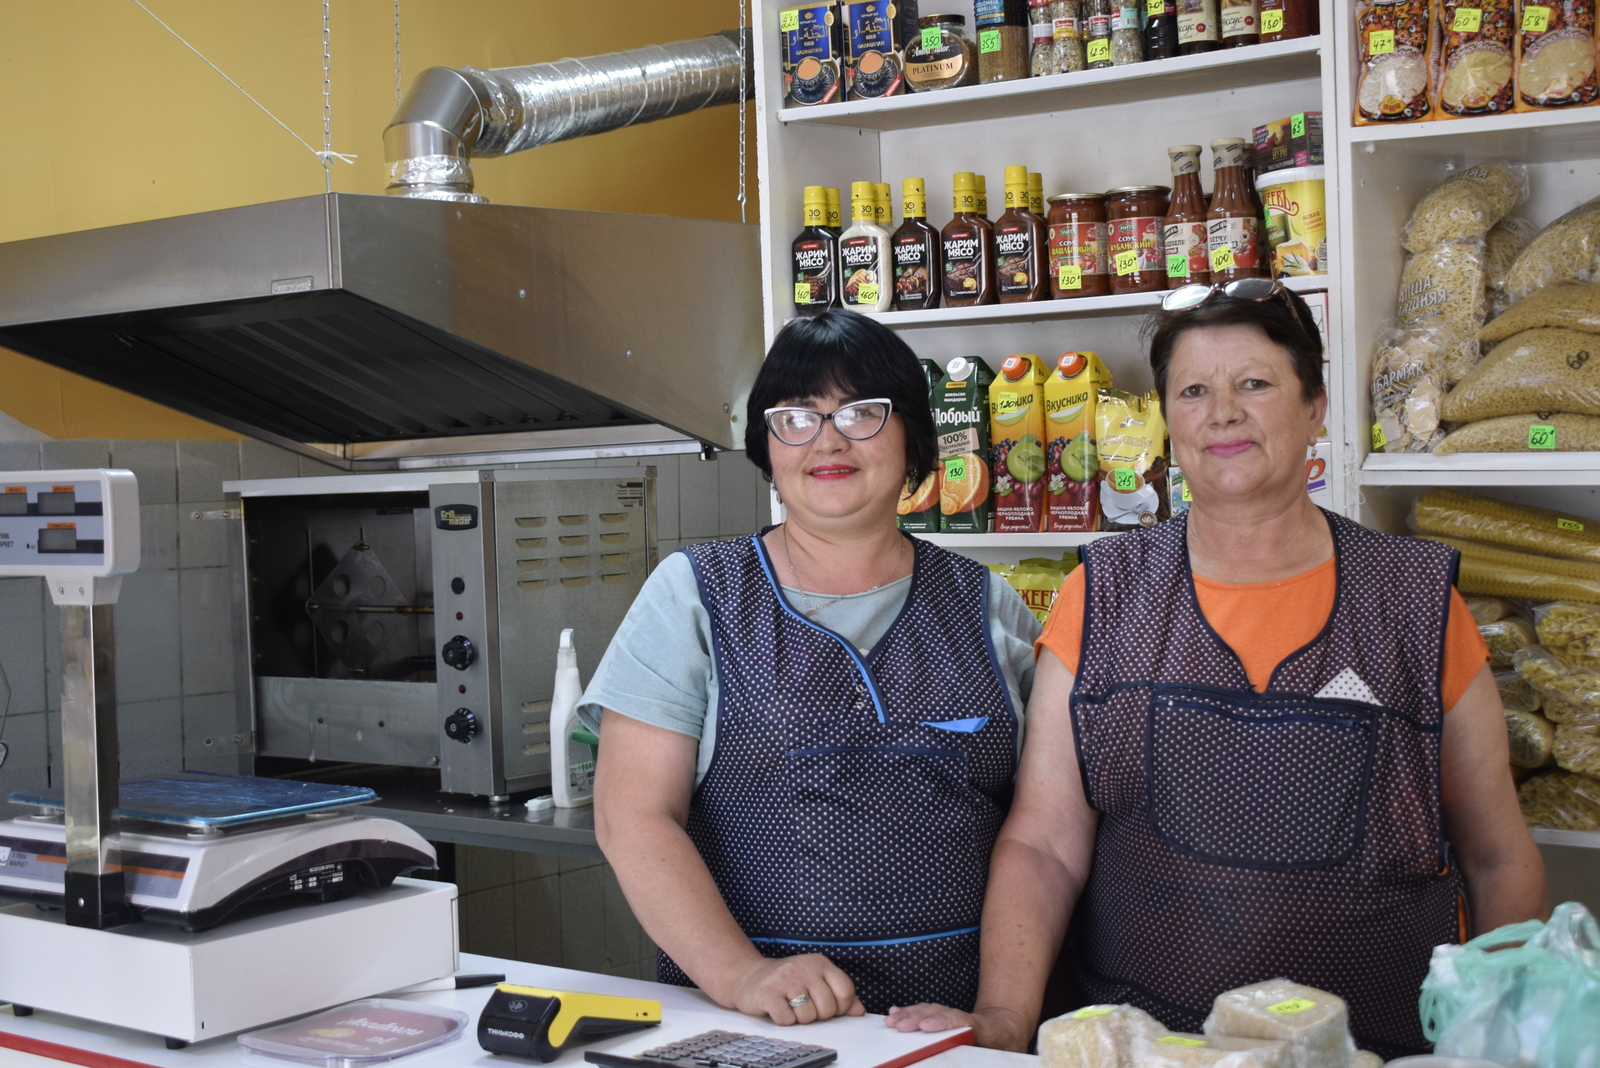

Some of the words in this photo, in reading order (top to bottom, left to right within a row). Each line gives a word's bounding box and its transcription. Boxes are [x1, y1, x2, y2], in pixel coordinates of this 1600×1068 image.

[1454, 17, 1470, 27] 60
[923, 36, 940, 47] 350
[912, 62, 954, 75] PLATINUM
[961, 195, 974, 203] 30
[808, 208, 821, 217] 30
[860, 204, 872, 213] 30
[943, 238, 979, 250] ЖАРИМ
[995, 232, 1029, 244] ЖАРИМ
[841, 244, 877, 256] ЖАРИМ
[894, 243, 925, 255] ЖАРИМ
[999, 241, 1025, 252] МЯСО
[1110, 240, 1151, 252] КУБАНСКИЙ
[795, 249, 828, 261] ЖАРИМ
[846, 253, 873, 264] МЯСО
[897, 252, 921, 263] МЯСО
[947, 247, 974, 258] МЯСО
[799, 257, 824, 268] МЯСО
[1119, 258, 1134, 269] 130
[1215, 254, 1229, 267] 100
[1061, 275, 1076, 286] 130
[1400, 275, 1432, 304] АПША
[1399, 288, 1447, 317] АШНЯЯ
[1046, 391, 1089, 413] Вкусника
[935, 406, 981, 427] Добрый
[942, 430, 968, 446] 100%
[1531, 431, 1549, 446] 60
[948, 447, 966, 455] ФРУКТЫ
[949, 467, 964, 478] 130
[487, 1027, 525, 1039] ТИНЬКОФФ
